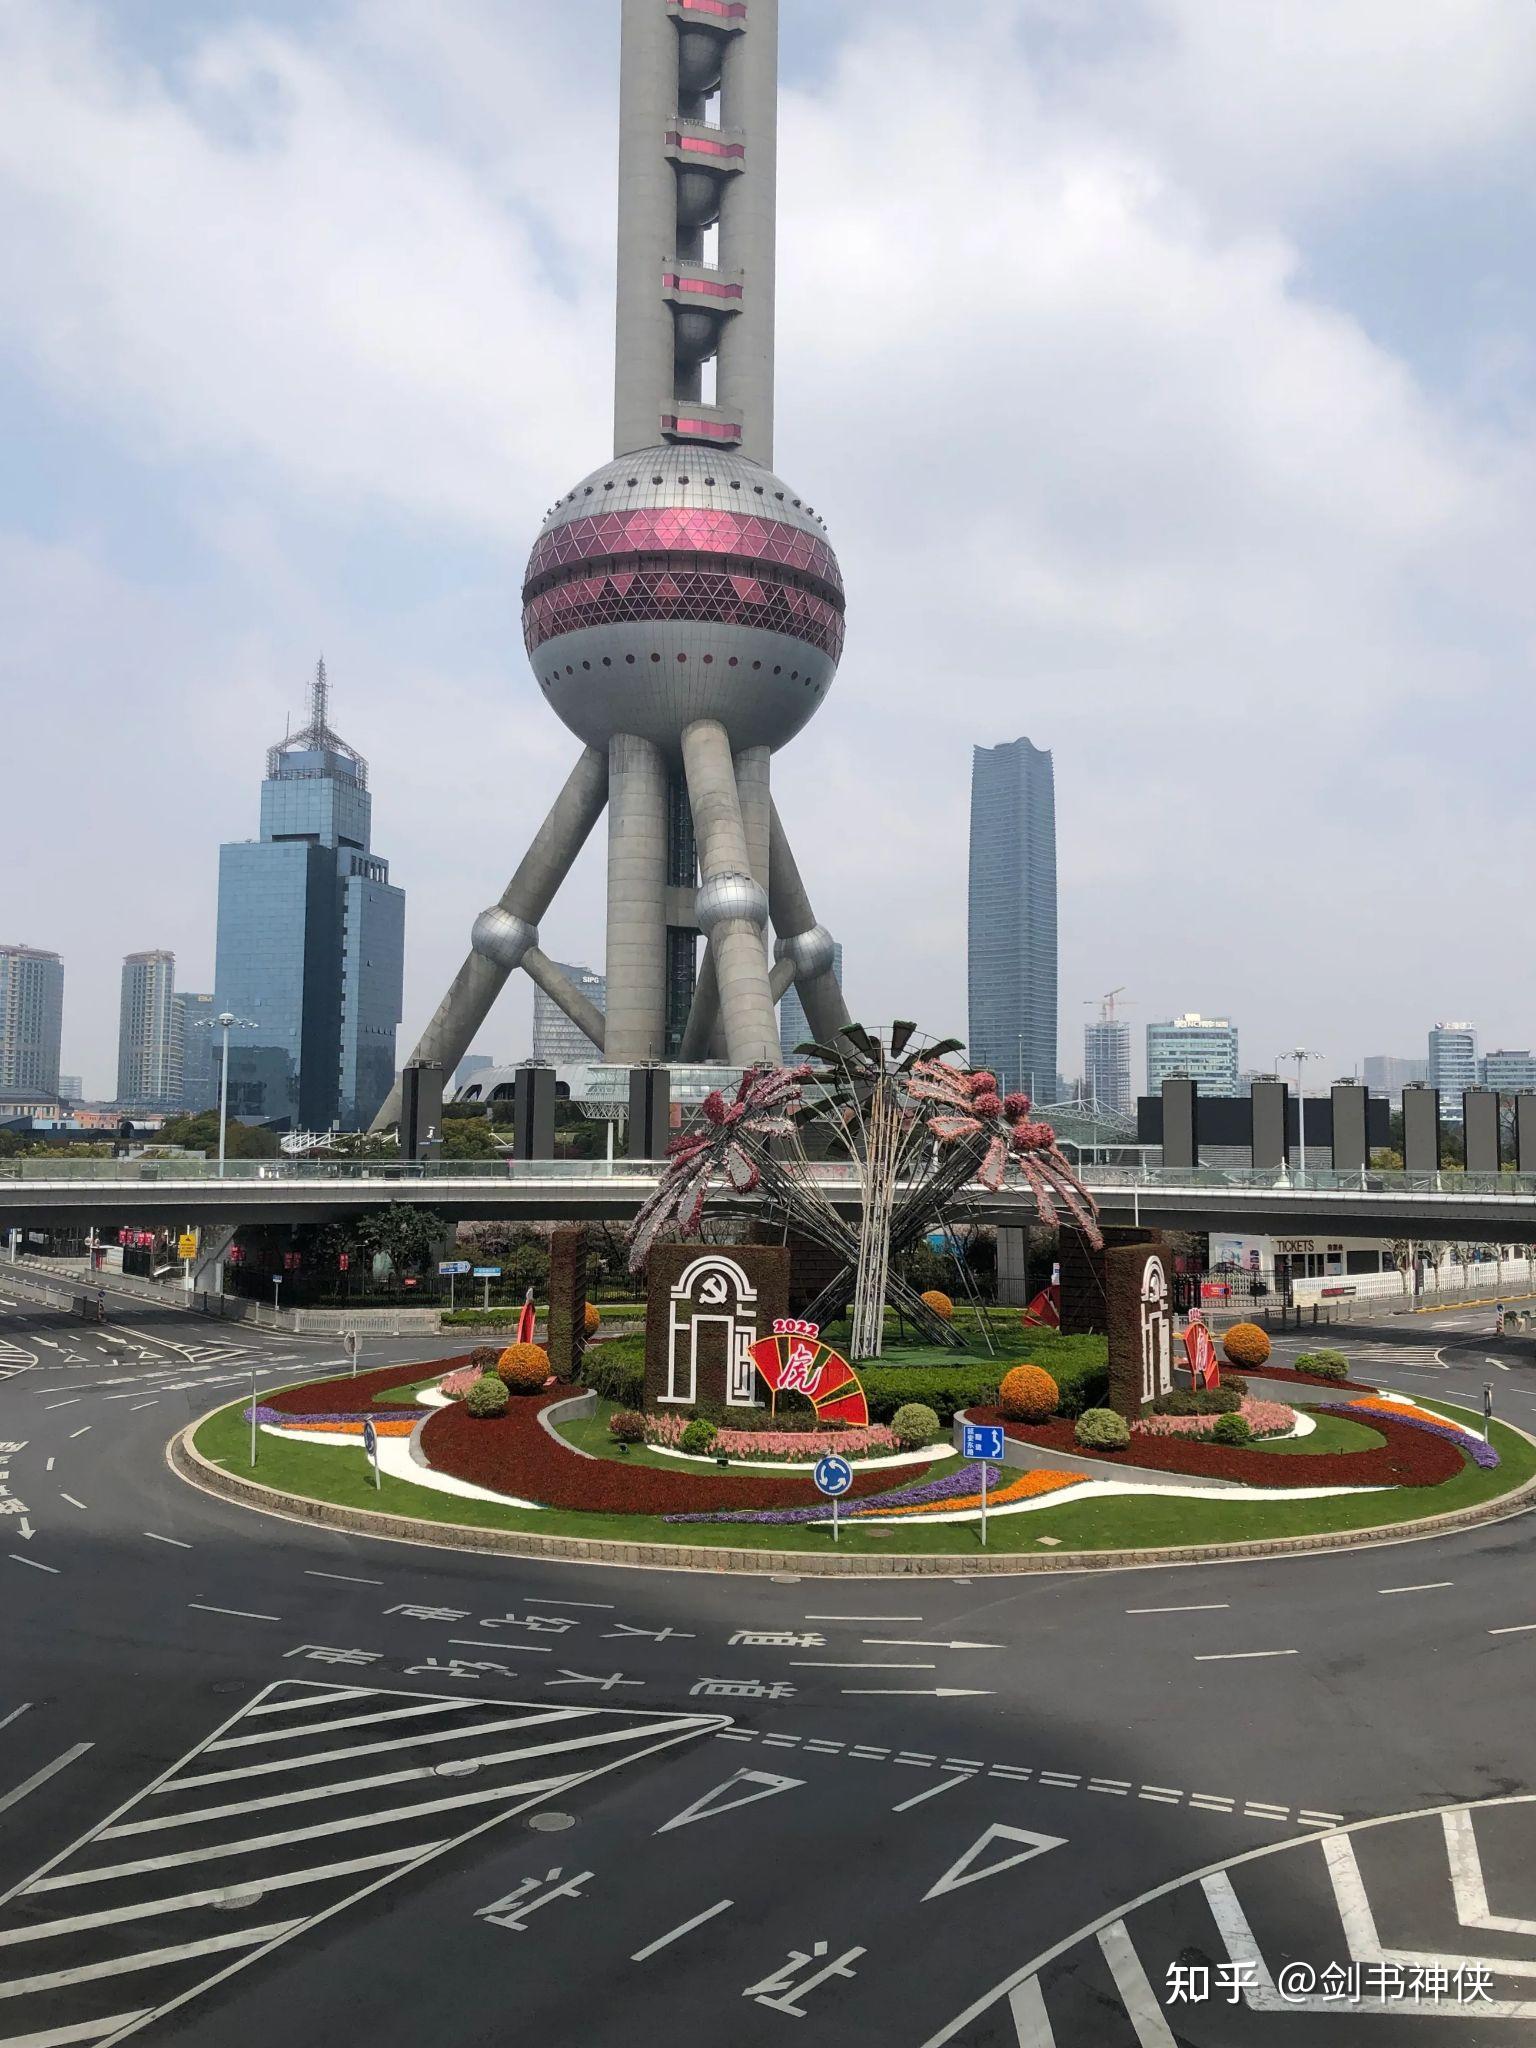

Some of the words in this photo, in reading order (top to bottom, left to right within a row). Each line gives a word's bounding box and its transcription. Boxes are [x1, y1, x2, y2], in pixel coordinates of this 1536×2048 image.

[582, 976, 600, 984] SIPG
[1276, 1239, 1315, 1253] TICKETS
[773, 1318, 820, 1339] 2022
[777, 1343, 823, 1395] 虎
[382, 1602, 827, 1649] 世纪大道
[283, 1643, 795, 1699] 世纪大道
